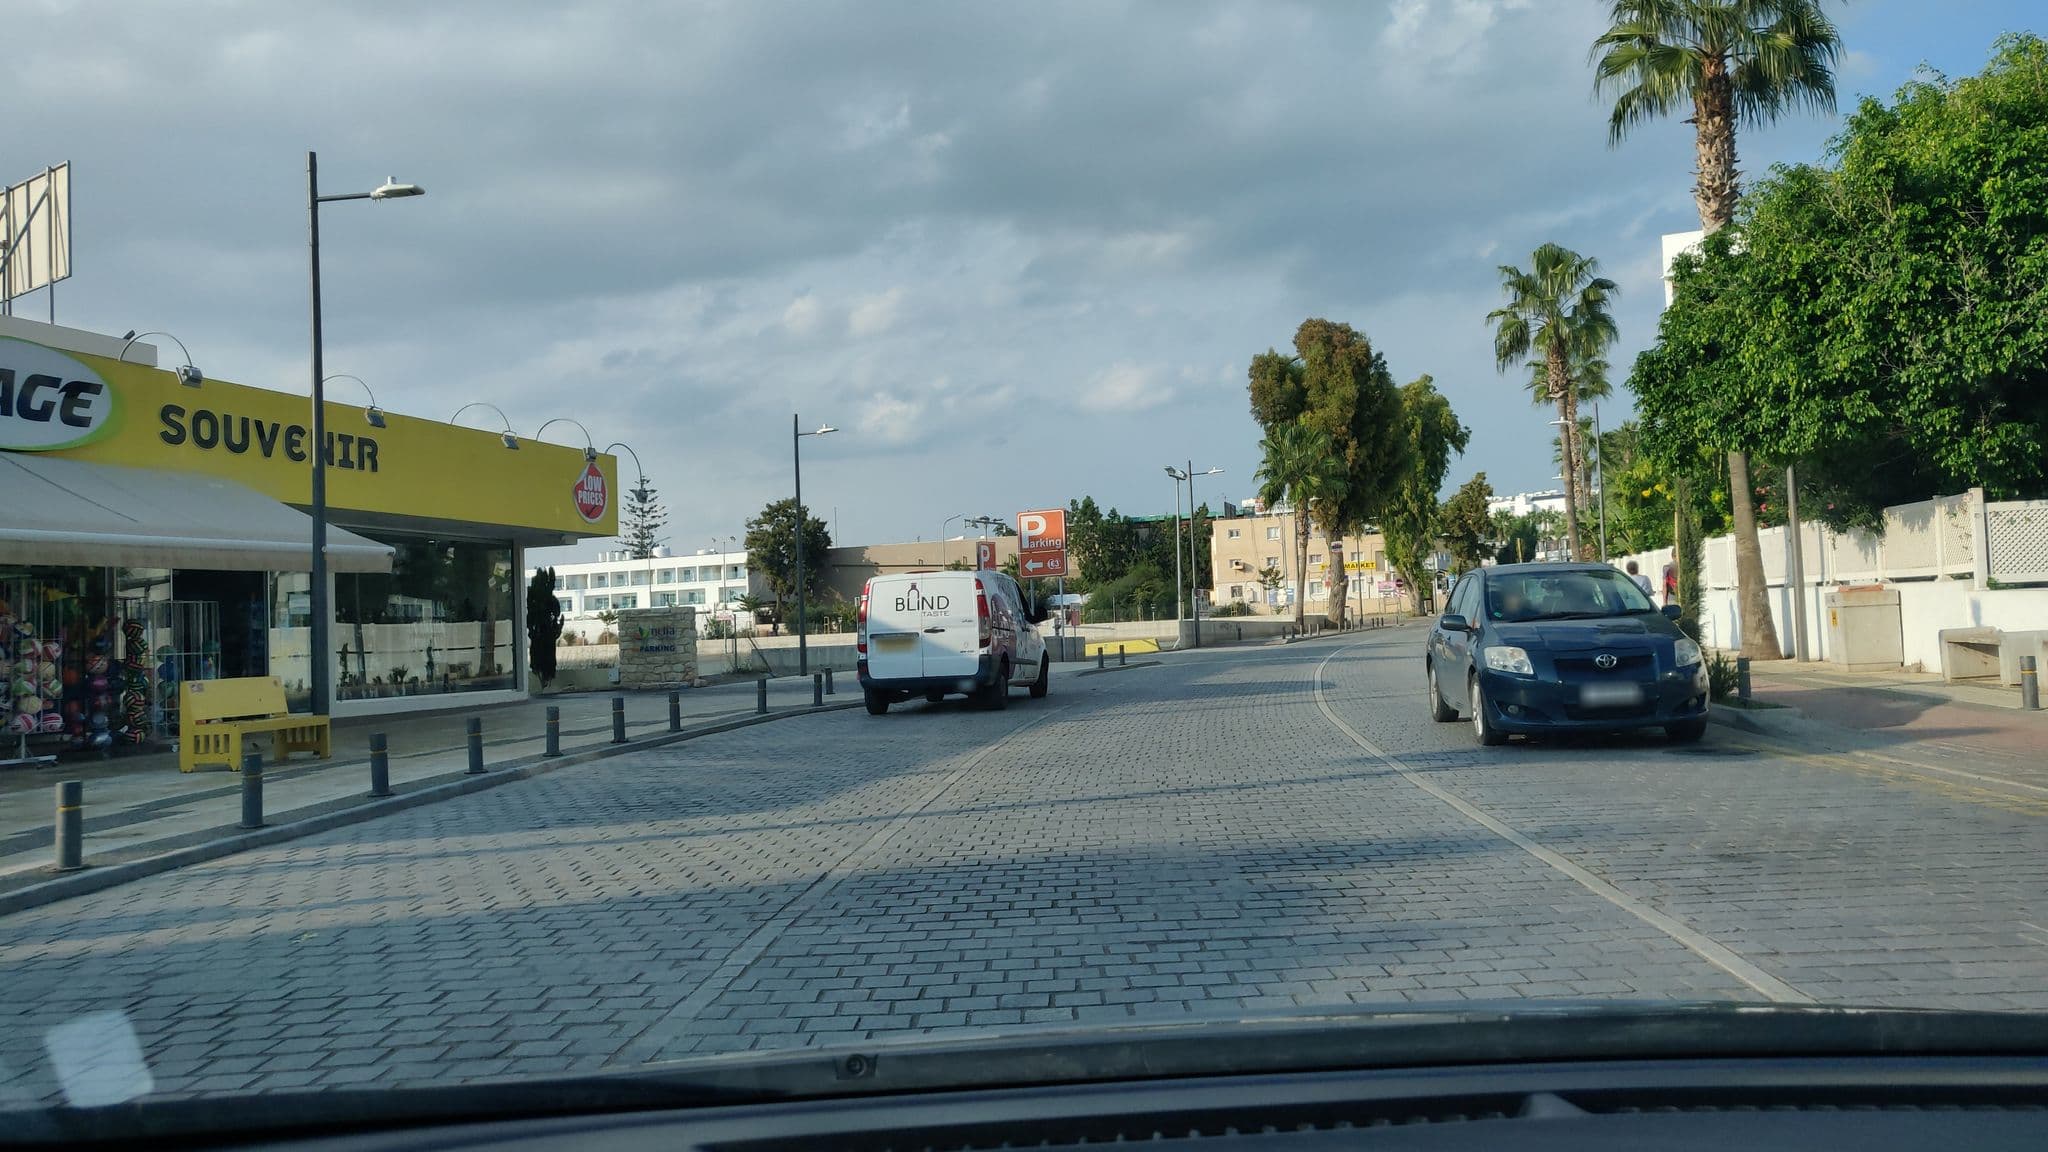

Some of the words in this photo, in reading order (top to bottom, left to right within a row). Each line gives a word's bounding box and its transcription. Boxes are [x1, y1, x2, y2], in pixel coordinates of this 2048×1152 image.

[583, 475, 602, 492] LOW
[578, 490, 603, 506] PRICES
[1020, 515, 1062, 549] Parking
[895, 595, 950, 612] BLIND
[639, 643, 676, 653] PARKING
